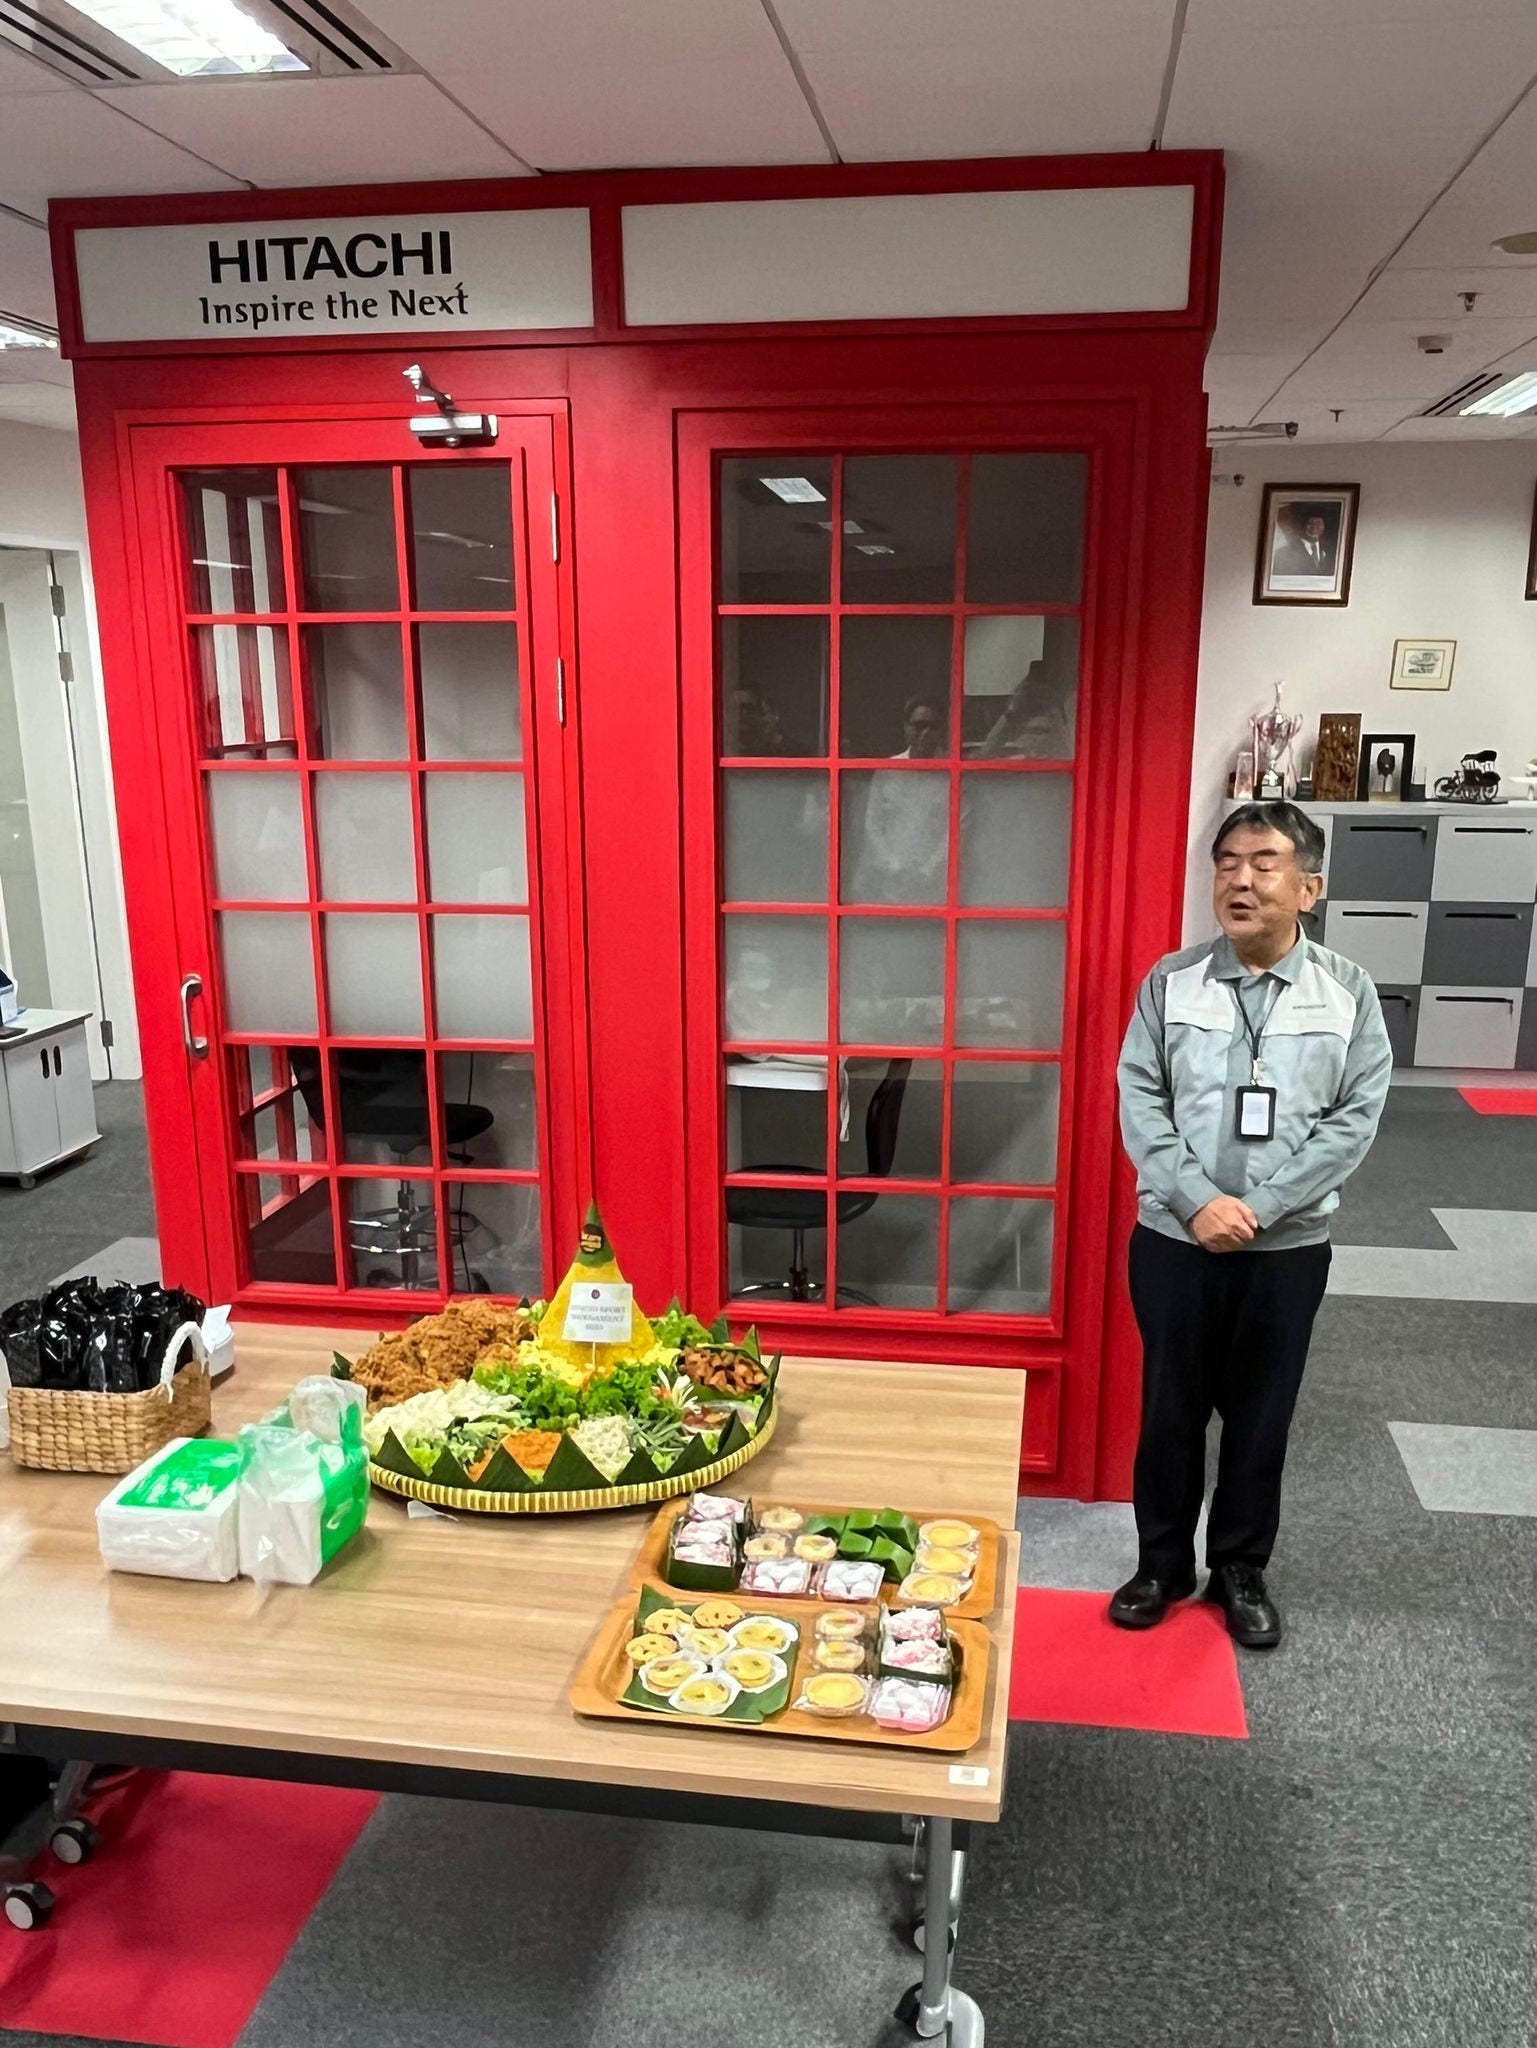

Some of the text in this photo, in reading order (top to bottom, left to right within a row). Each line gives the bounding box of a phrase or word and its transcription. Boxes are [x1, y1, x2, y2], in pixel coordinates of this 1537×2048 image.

[208, 231, 452, 284] HITACHI
[198, 282, 469, 330] Inspire the Next
